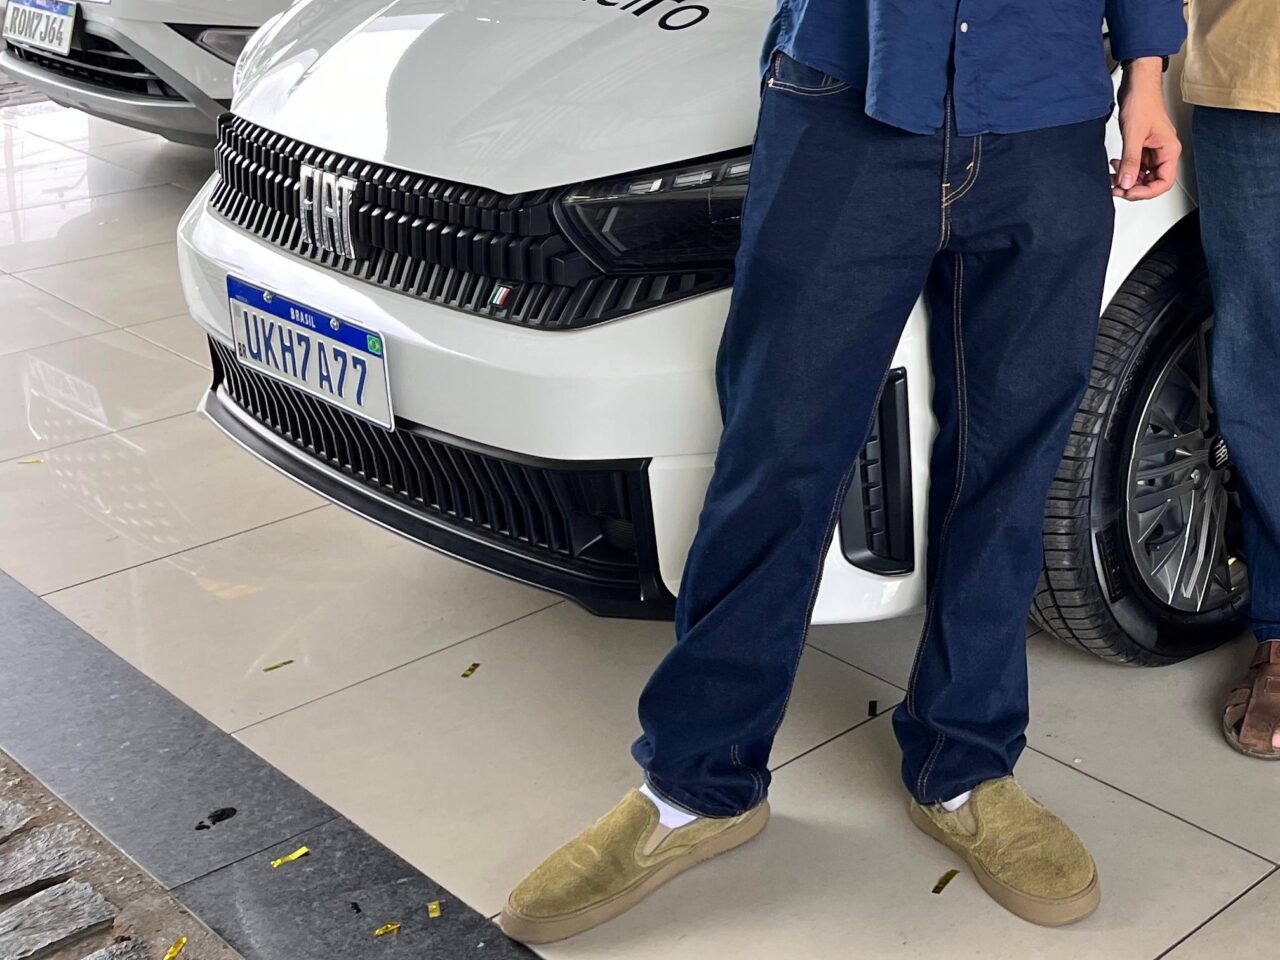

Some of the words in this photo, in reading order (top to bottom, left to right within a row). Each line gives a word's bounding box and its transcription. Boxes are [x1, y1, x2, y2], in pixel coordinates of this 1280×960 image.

[300, 161, 357, 259] FIAT
[243, 310, 367, 407] UKH7A77
[289, 307, 316, 328] BRASIL
